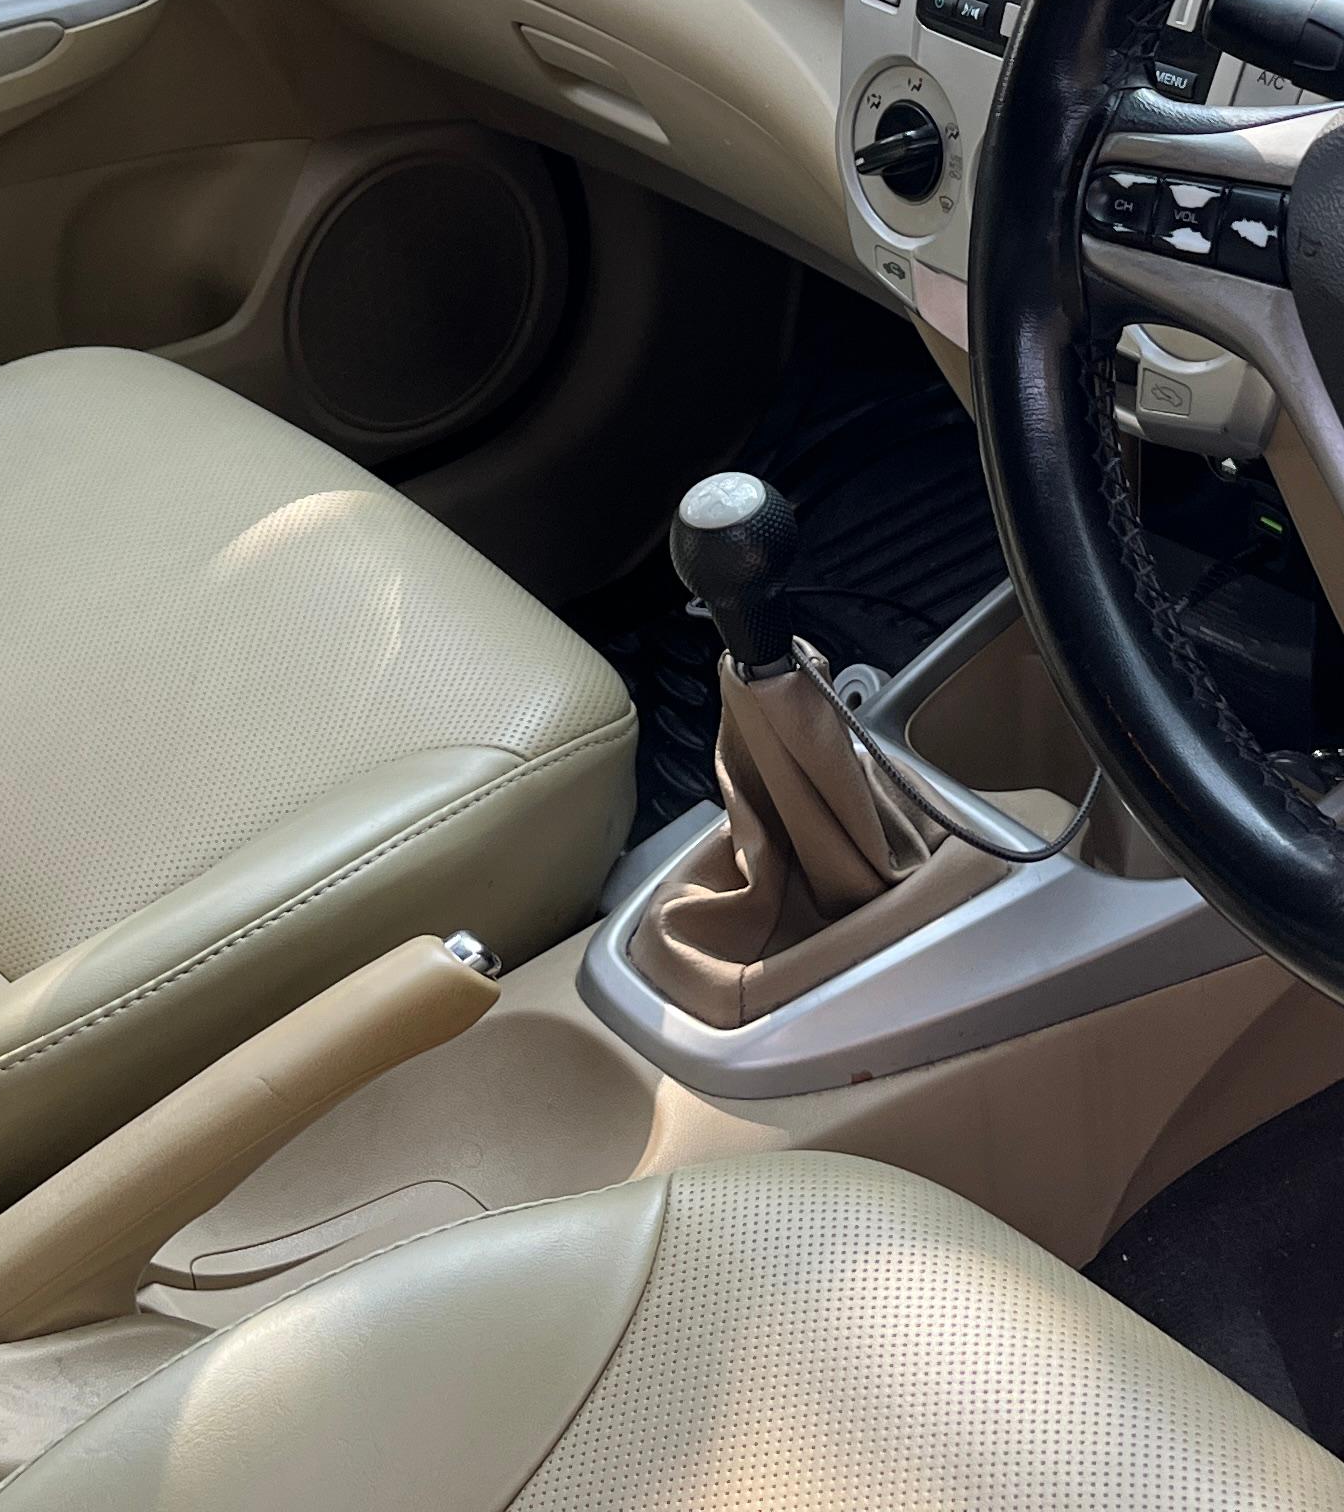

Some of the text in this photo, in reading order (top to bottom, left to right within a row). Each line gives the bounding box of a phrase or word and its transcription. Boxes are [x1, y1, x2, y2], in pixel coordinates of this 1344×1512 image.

[1155, 70, 1189, 89] MENU
[1257, 71, 1285, 91] A/C
[1114, 199, 1134, 213] CH
[1173, 208, 1200, 225] VOL
